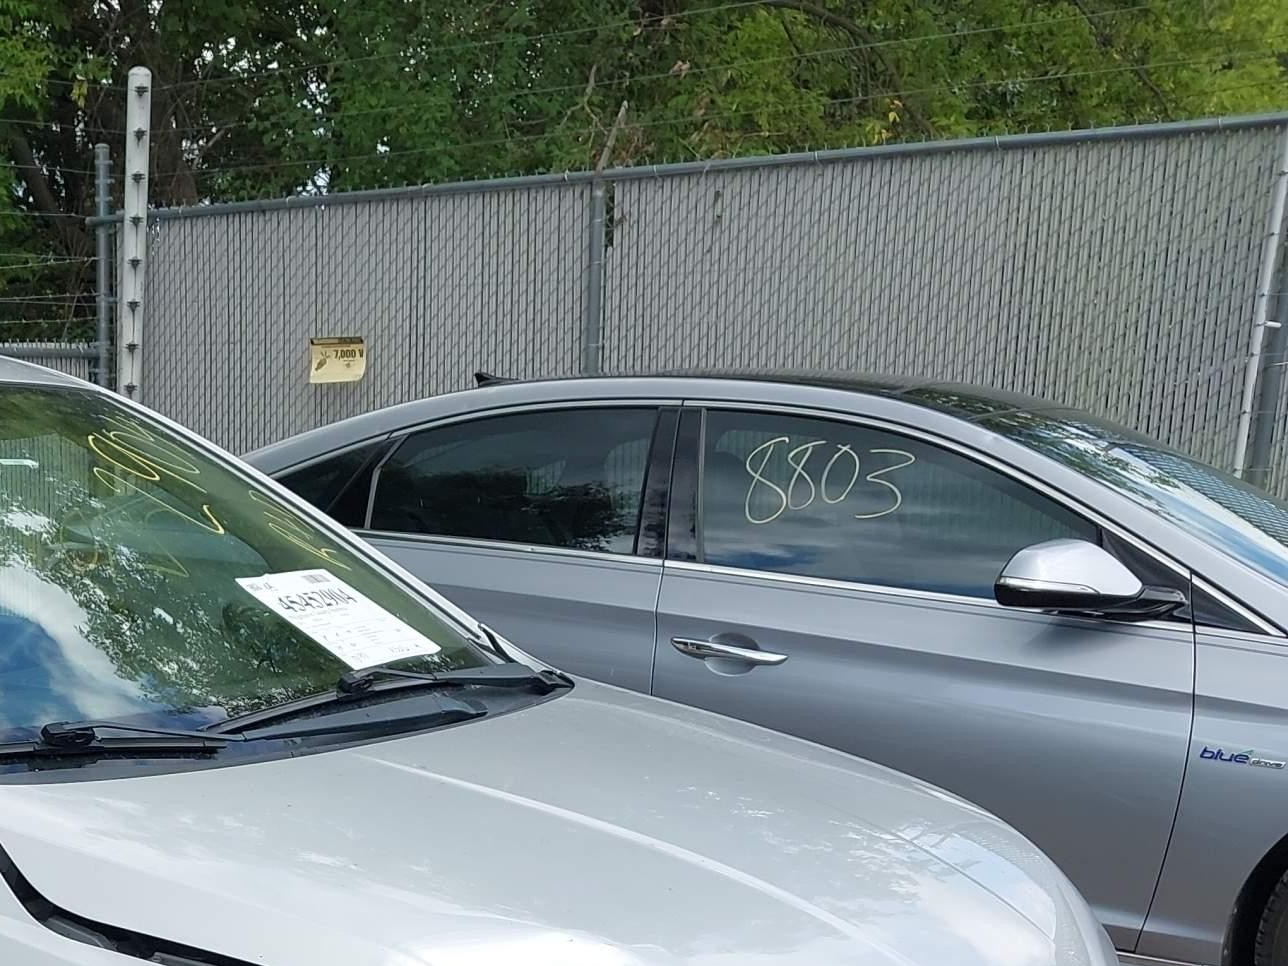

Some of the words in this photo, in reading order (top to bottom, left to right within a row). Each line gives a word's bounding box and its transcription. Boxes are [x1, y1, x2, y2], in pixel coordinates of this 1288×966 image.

[333, 349, 357, 360] 7,000
[358, 348, 364, 358] V
[745, 436, 916, 524] 8803
[277, 587, 359, 613] 45452904
[1199, 745, 1250, 764] blue
